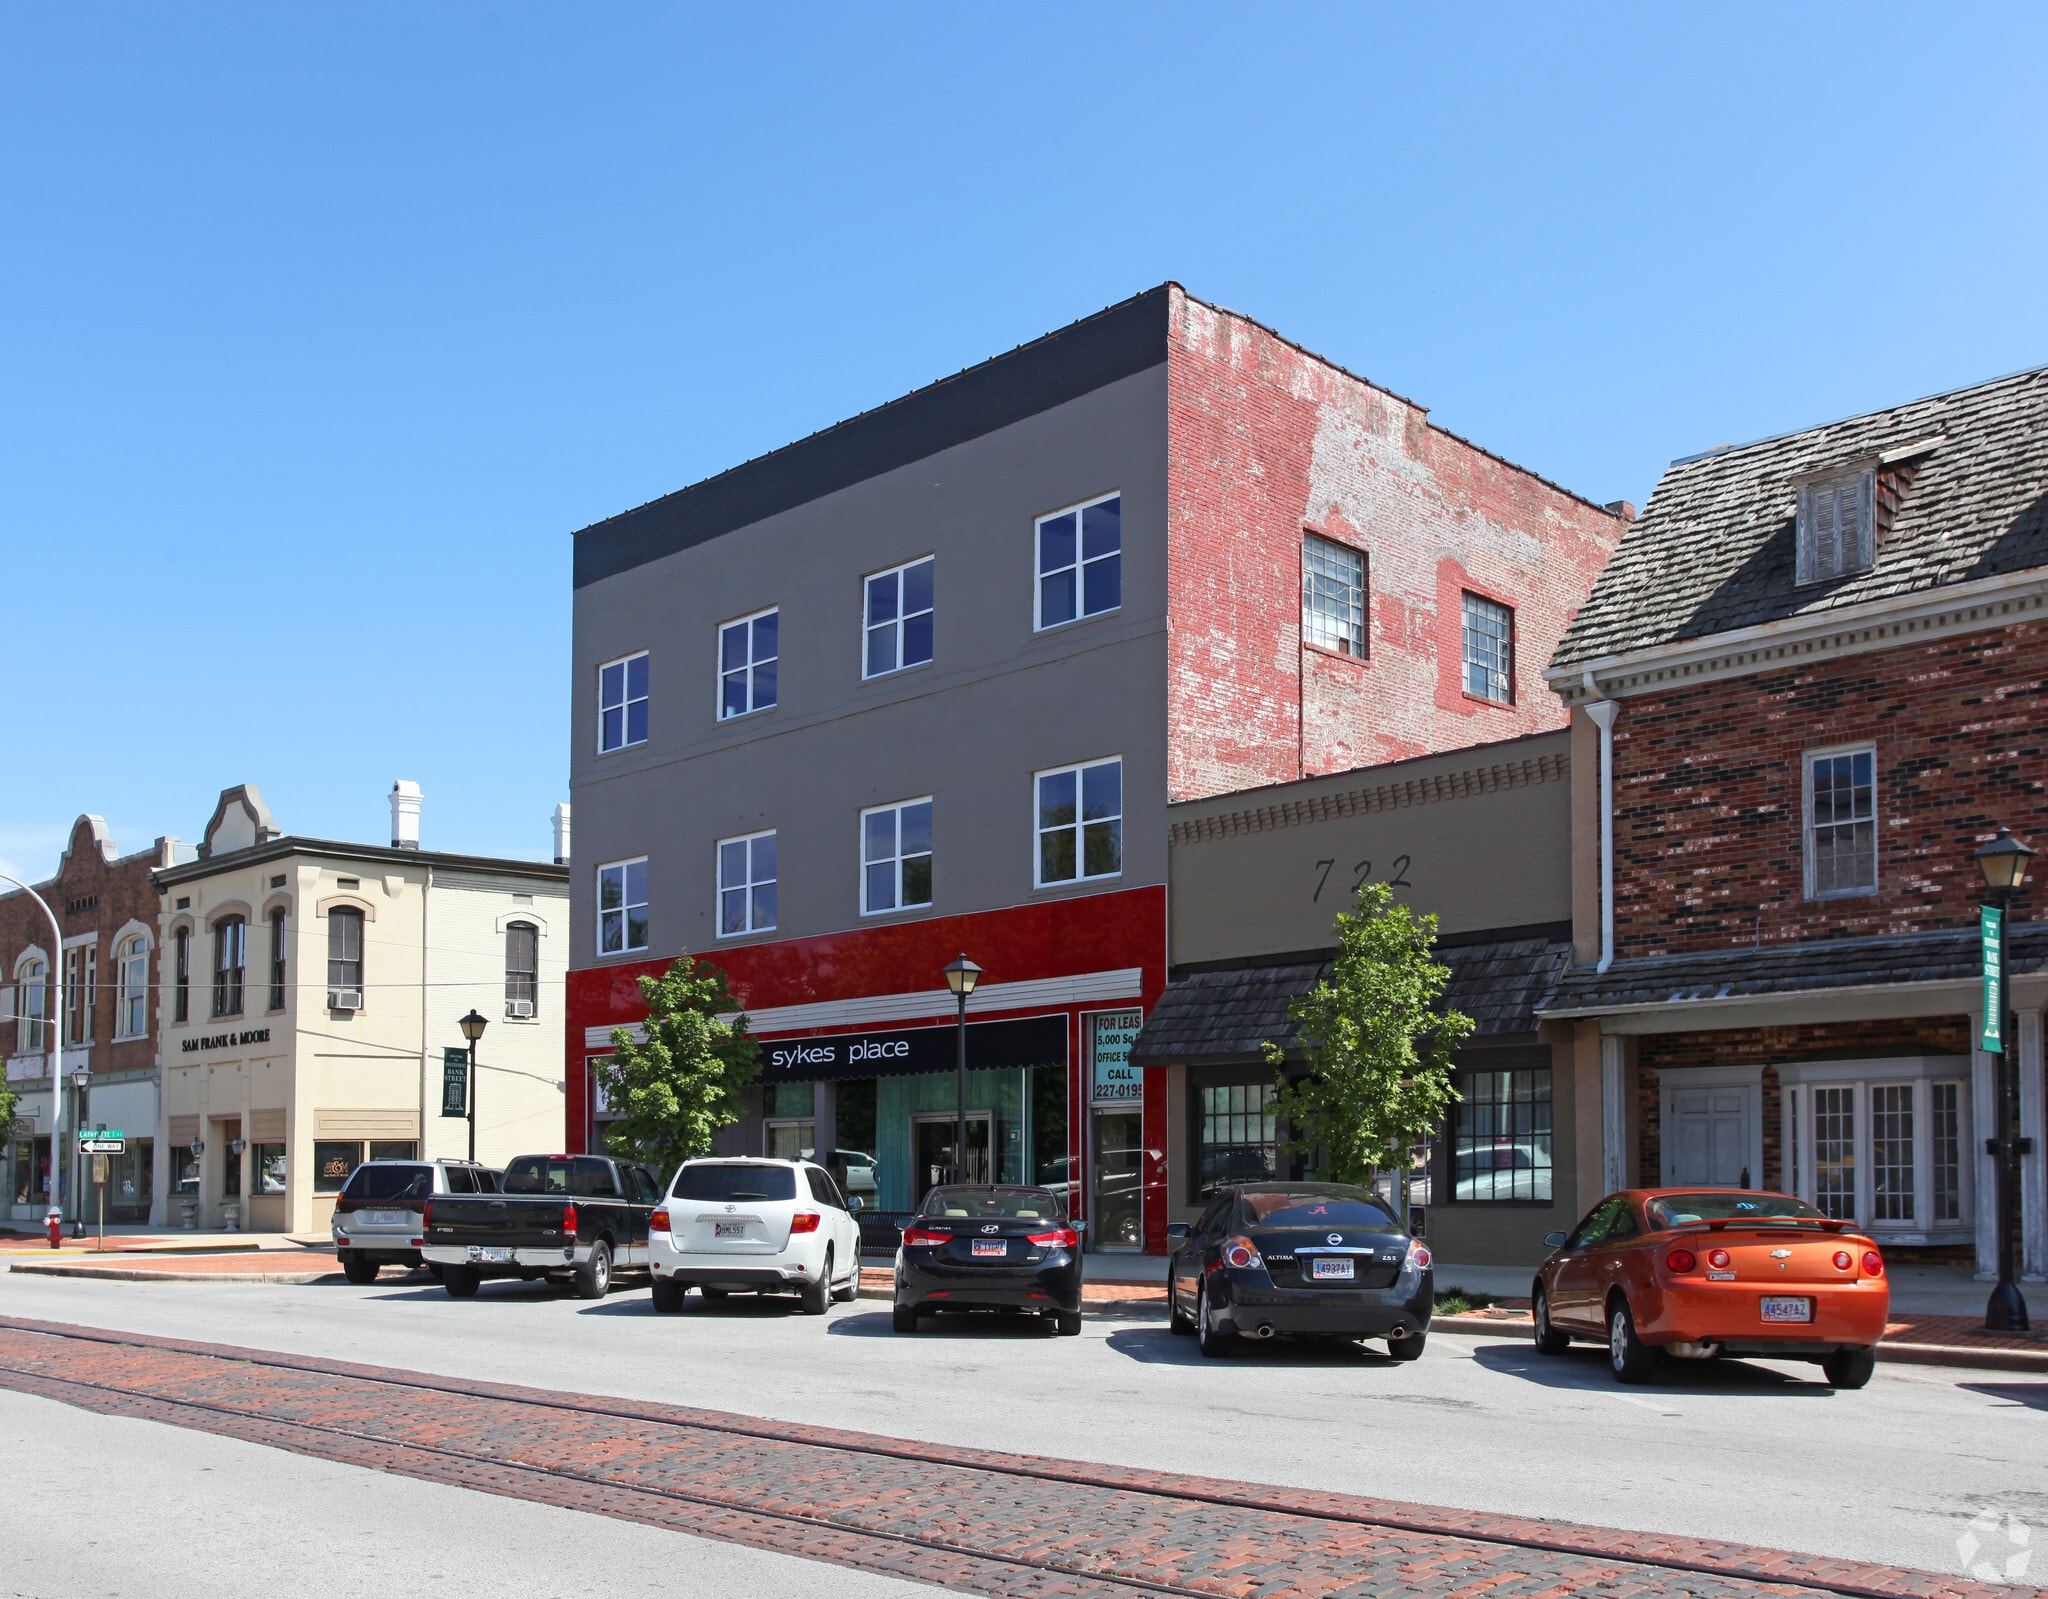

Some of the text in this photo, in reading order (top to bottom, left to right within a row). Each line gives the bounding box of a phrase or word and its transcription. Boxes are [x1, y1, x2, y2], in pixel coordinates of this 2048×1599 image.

[1313, 854, 1412, 903] 722
[1099, 1015, 1142, 1030] FOR LEAS
[182, 1028, 271, 1052] SAM FRANK & MOORE
[1097, 1034, 1120, 1047] 5,000
[772, 1039, 909, 1068] sykes place
[1097, 1051, 1121, 1063] OFFICE
[447, 1068, 464, 1076] BANK
[1107, 1069, 1133, 1080] CALL
[1764, 1303, 1806, 1316] 44547AZ
